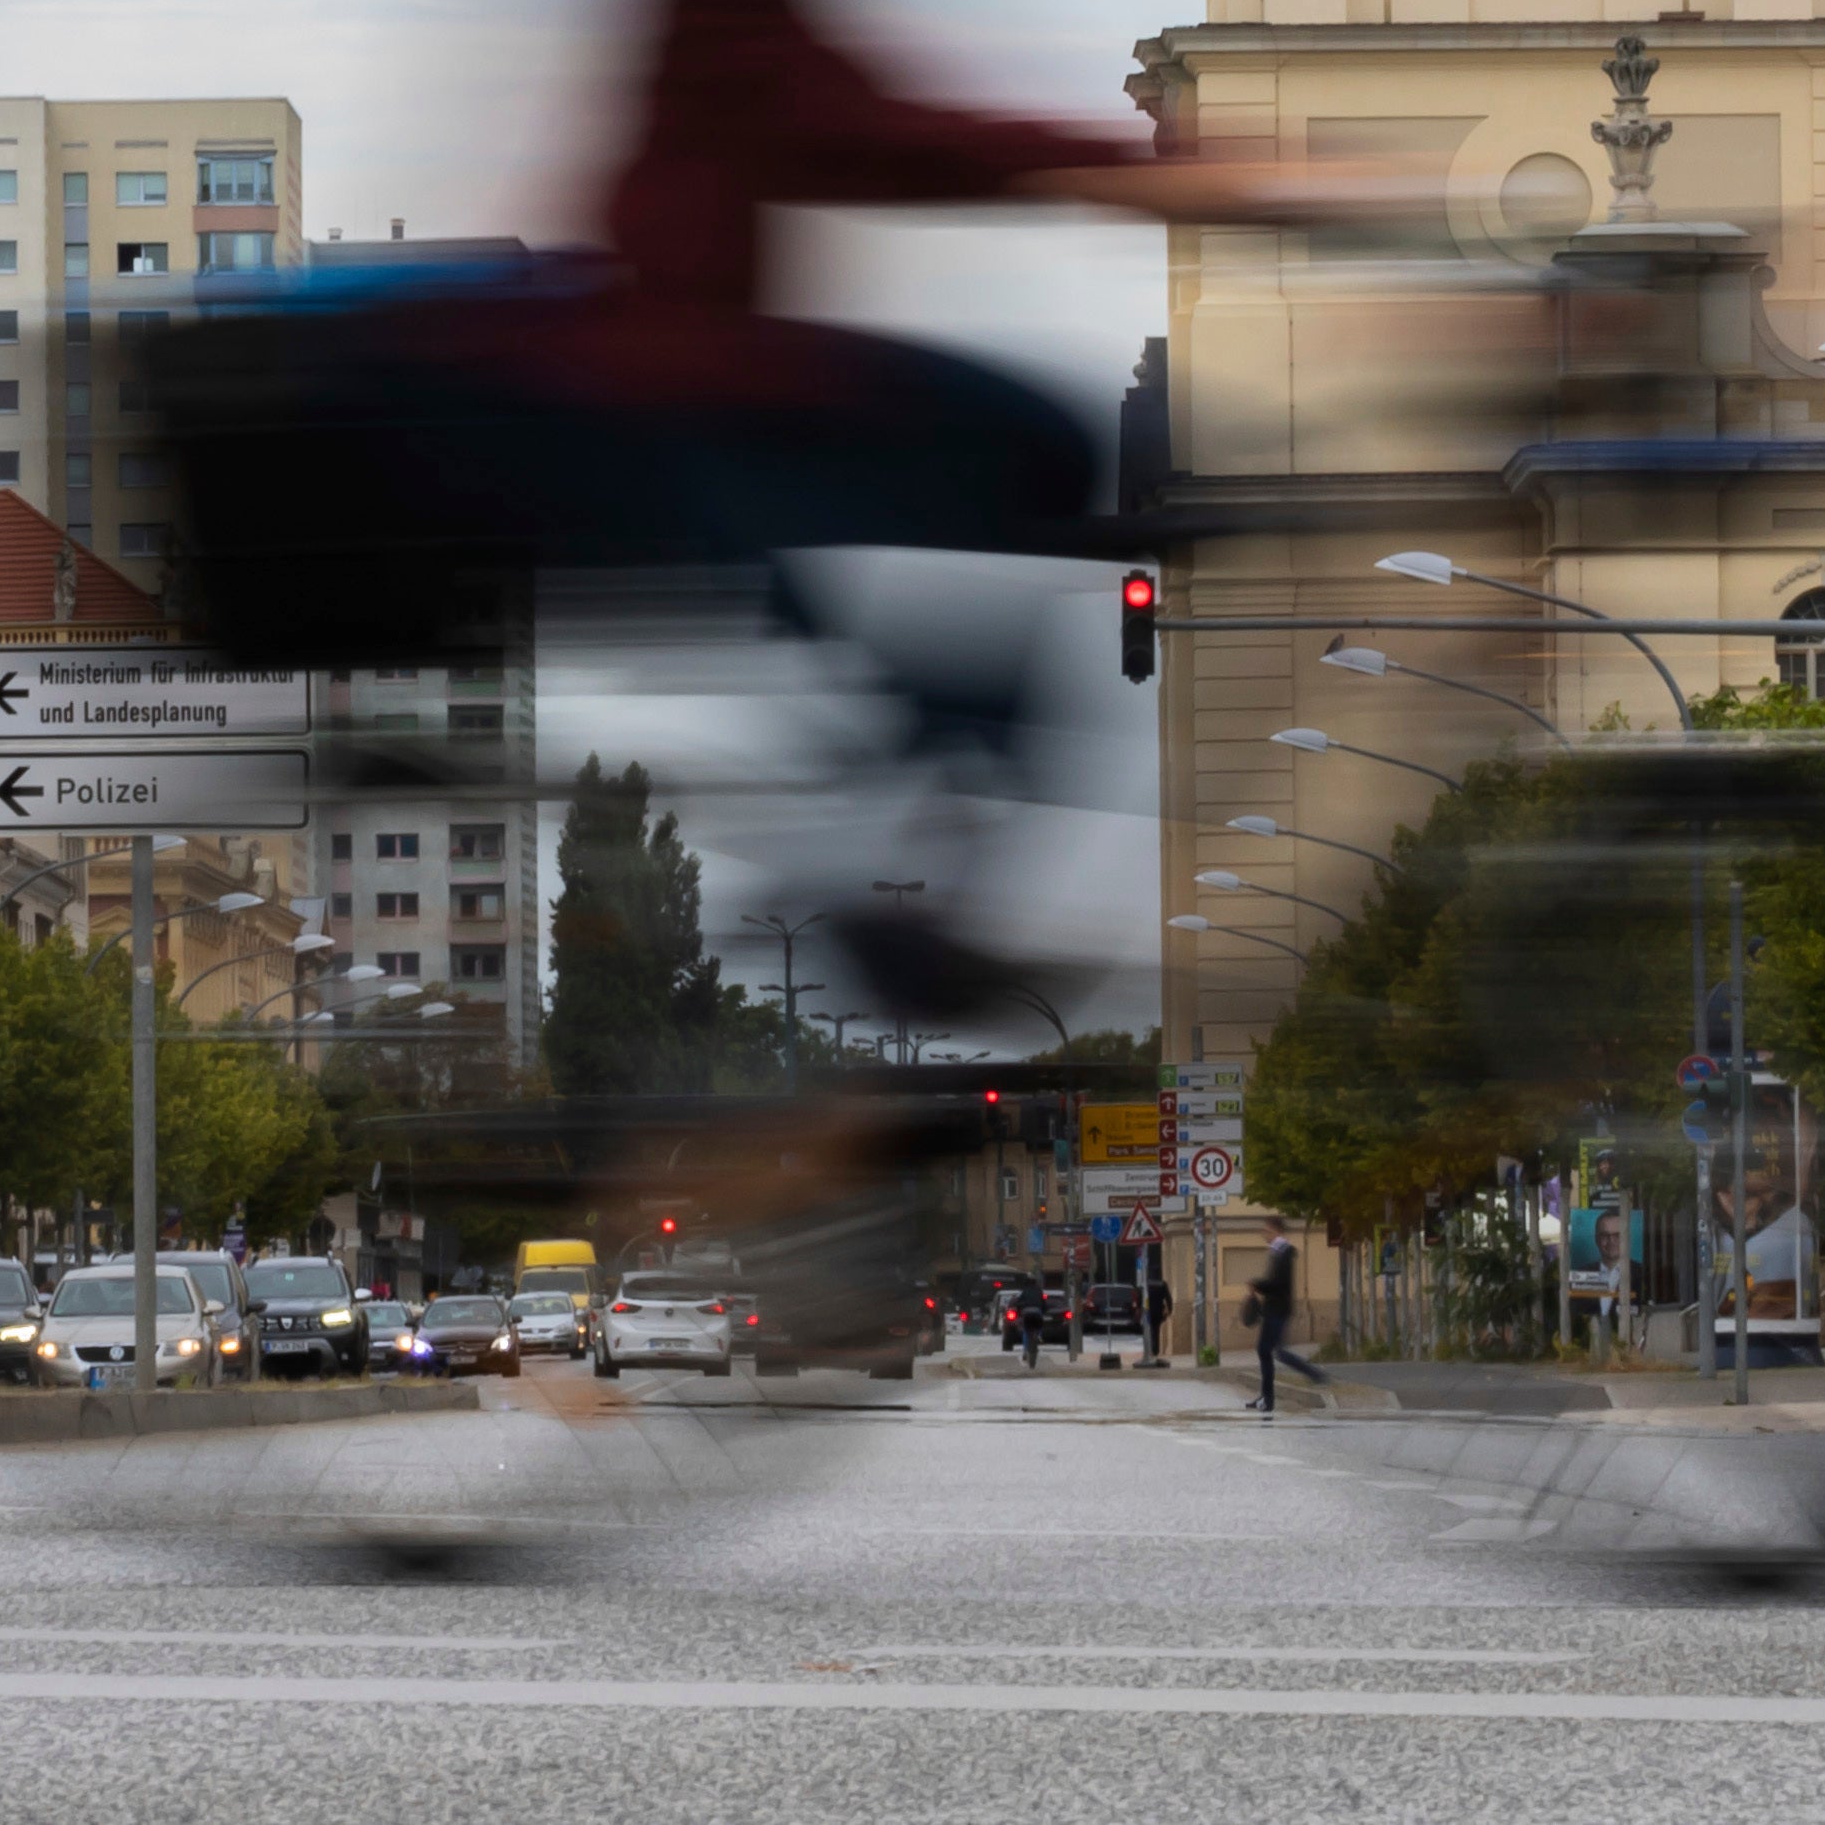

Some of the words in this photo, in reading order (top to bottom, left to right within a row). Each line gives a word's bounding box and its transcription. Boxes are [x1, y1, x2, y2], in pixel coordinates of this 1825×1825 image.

[40, 662, 141, 685] Ministerium
[151, 661, 176, 684] für
[40, 703, 74, 724] und
[84, 701, 227, 728] Landesplanung
[57, 777, 158, 804] Polizei
[1199, 1158, 1224, 1178] 30
